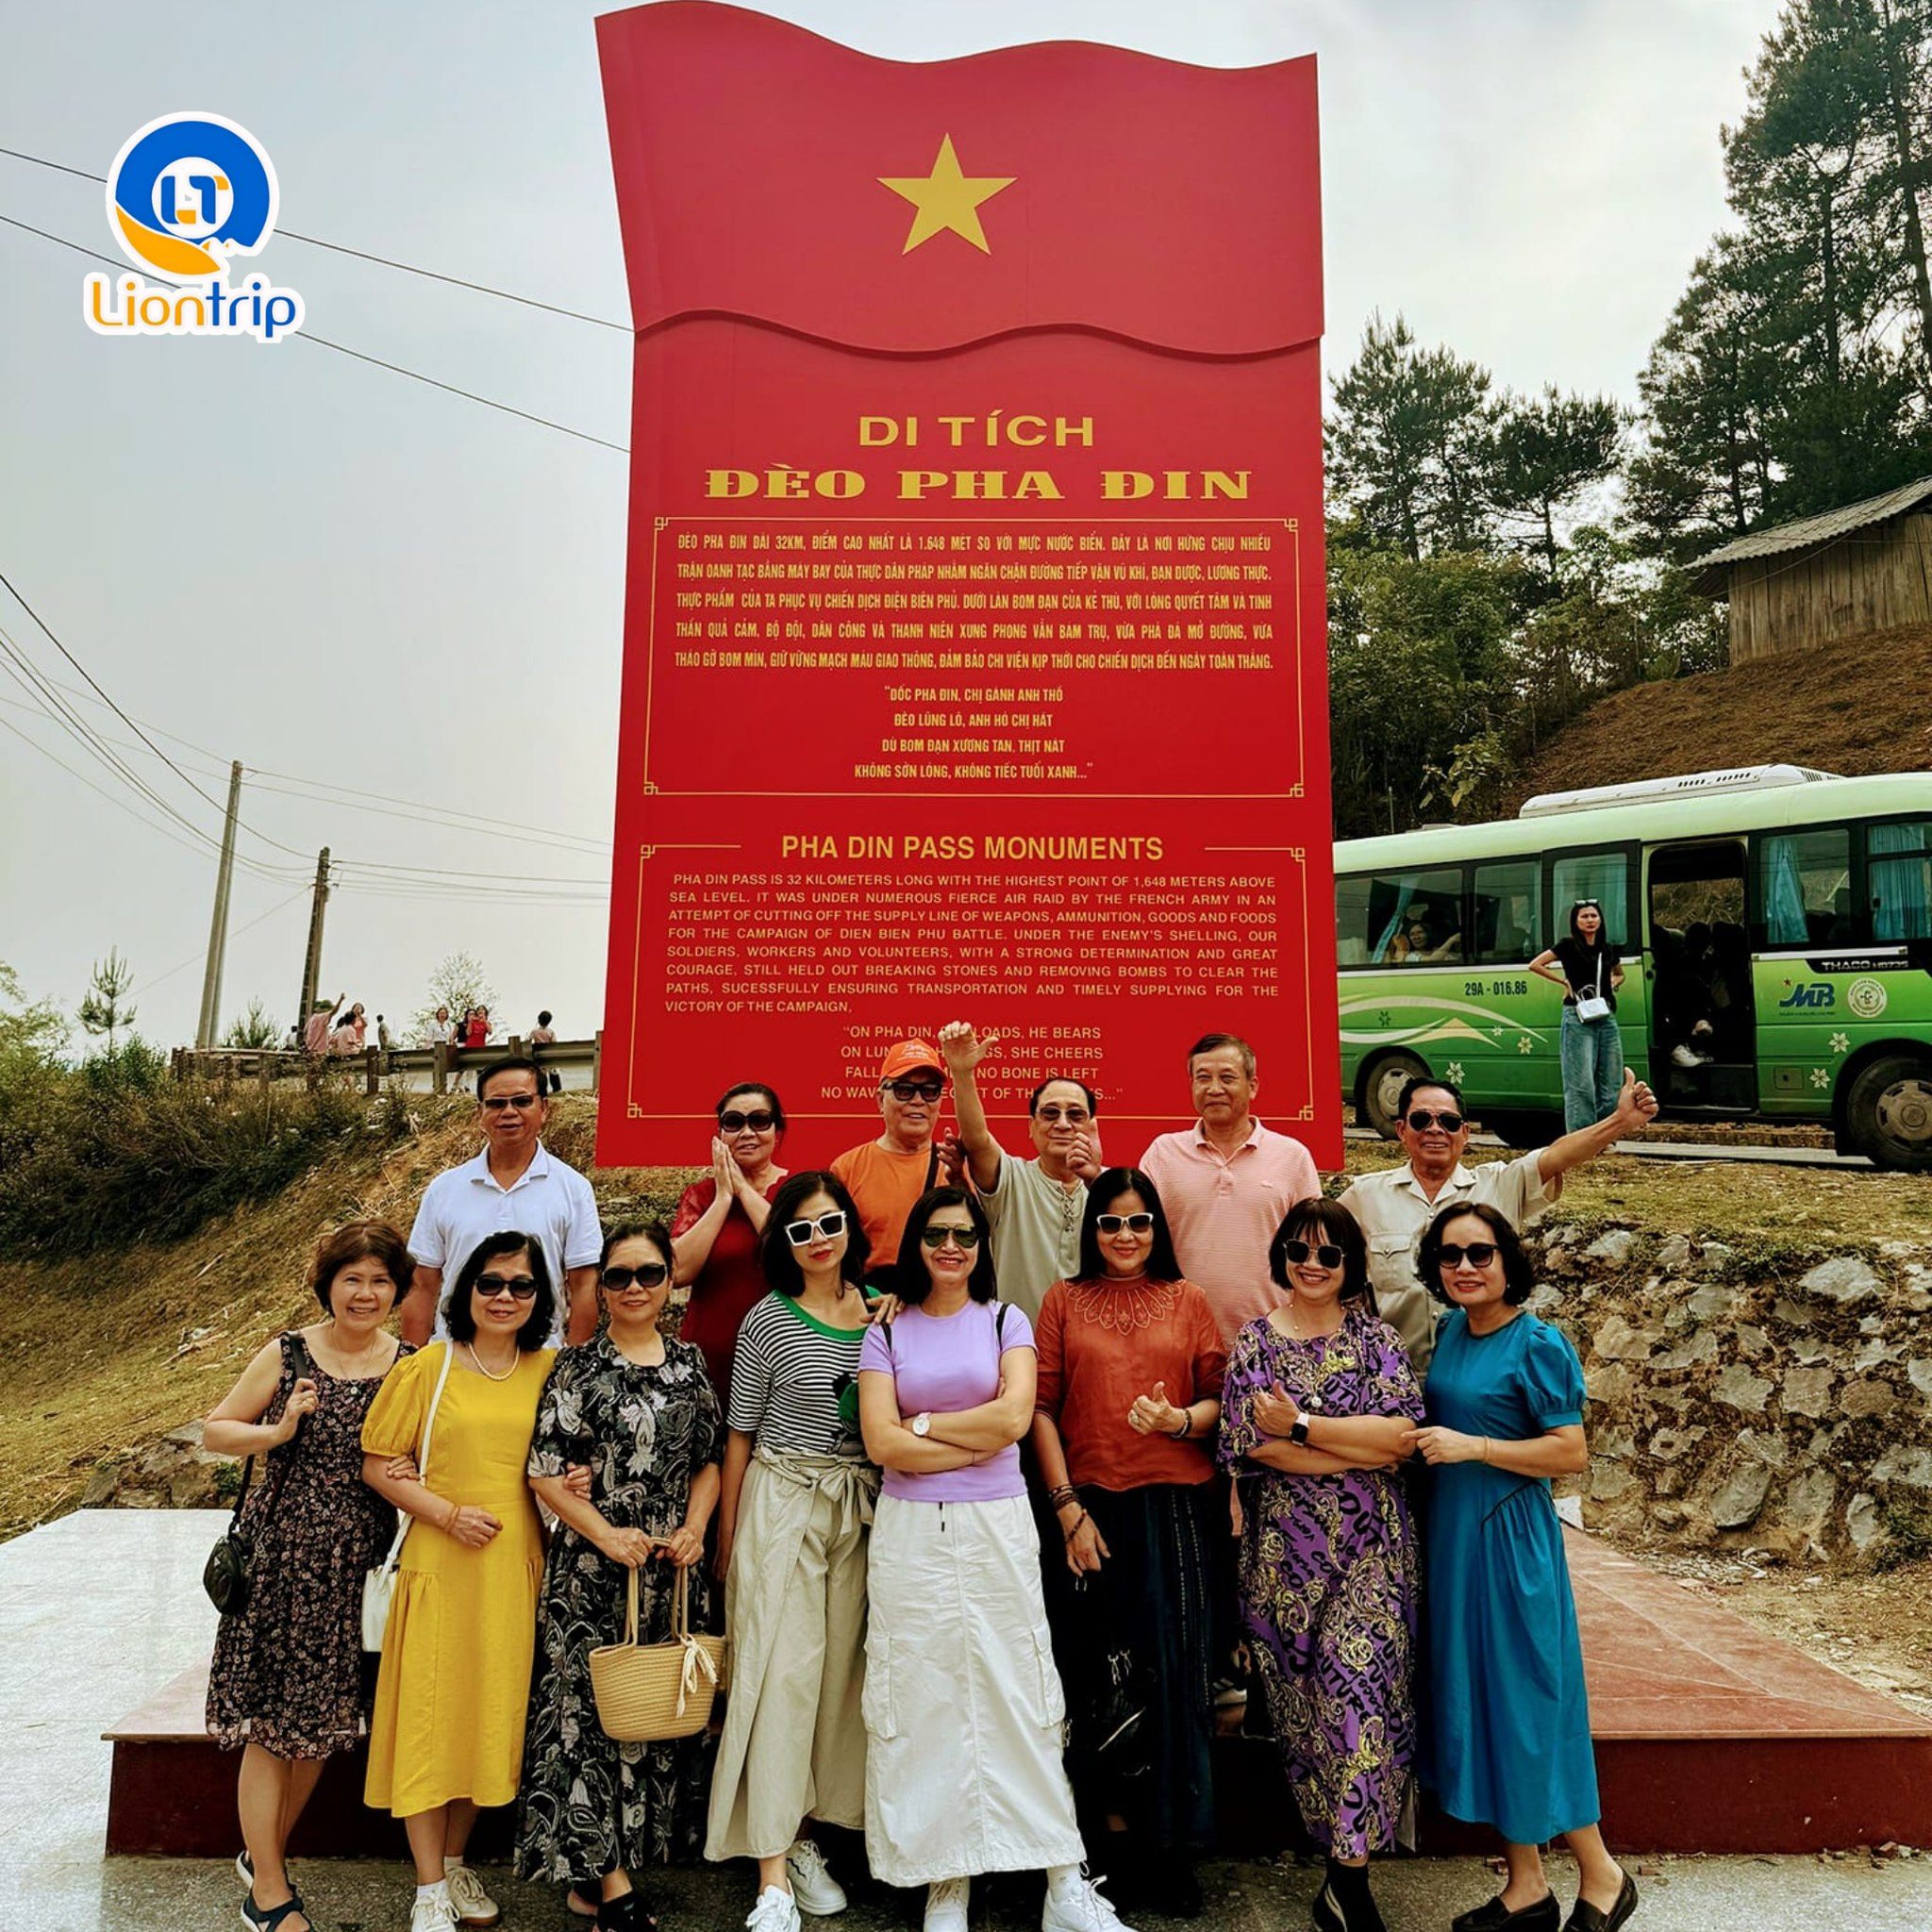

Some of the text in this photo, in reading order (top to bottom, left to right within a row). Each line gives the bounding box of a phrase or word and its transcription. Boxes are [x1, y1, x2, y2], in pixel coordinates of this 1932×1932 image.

[859, 408, 1093, 447] DI TÍCH
[705, 462, 1252, 500] ĐÈO PHA ĐIN
[703, 534, 724, 549] PHA
[774, 535, 807, 551] 32KM,
[842, 535, 863, 551] CAO
[976, 535, 991, 551] SO
[782, 835, 1163, 860] PHA DIN PASS MONUMENTS
[673, 874, 702, 885] PHA
[705, 874, 728, 885] DIN
[731, 874, 768, 886] PASS
[770, 874, 784, 886] IS
[805, 874, 892, 886] KILOMETERS
[895, 874, 934, 886] LONG
[937, 874, 972, 886] WITH
[974, 874, 1002, 887] THE
[1005, 874, 1065, 887] HIGHEST
[1068, 875, 1108, 887] POINT
[1111, 875, 1129, 887] OF
[1170, 875, 1226, 888] METERS
[1229, 875, 1275, 888] ABOVE
[669, 891, 697, 903] SEA
[757, 891, 770, 903] IT
[775, 891, 806, 904] WAS
[811, 891, 859, 904] UNDER
[865, 892, 942, 905] NUMEROUS
[948, 892, 997, 905] FIERCE
[1004, 892, 1026, 904] AIR
[1033, 892, 1065, 905] RAID
[1071, 893, 1090, 905] BY
[1095, 893, 1123, 905] THE
[1128, 893, 1185, 906] FRENCH
[1191, 893, 1230, 906] ARMY
[1237, 894, 1251, 906] IN
[1257, 894, 1276, 906] AN
[668, 909, 731, 921] ATTEMPT
[732, 909, 751, 922] OF
[753, 909, 813, 922] CUTTING
[815, 909, 842, 922] OFF
[843, 909, 872, 922] THE
[874, 909, 926, 922] SUPPLY
[928, 910, 958, 922] LINE
[961, 910, 980, 923] OF
[1147, 911, 1197, 924] GOODS
[1198, 911, 1227, 924] AND
[1229, 911, 1277, 924] FOODS
[668, 927, 696, 939] FOR
[703, 927, 729, 940] THE
[736, 927, 808, 940] CAMPAIGN
[814, 927, 833, 940] OF
[840, 927, 872, 940] DIEN
[878, 928, 910, 940] BIEN
[917, 928, 946, 941] PHU
[1013, 928, 1061, 941] UNDER
[1068, 929, 1095, 941] THE
[1248, 930, 1277, 942] OUR
[746, 945, 816, 958] WORKERS
[823, 946, 852, 958] AND
[958, 946, 993, 958] WITH
[1000, 947, 1010, 958] A
[1016, 946, 1073, 958] STRONG
[1079, 947, 1190, 959] DETERMINATION
[1196, 948, 1226, 959] AND
[1231, 948, 1278, 960] GREAT
[743, 964, 781, 976] STILL
[788, 964, 825, 976] HELD
[831, 964, 858, 976] OUT
[865, 964, 937, 976] BREAKING
[942, 964, 998, 976] STONES
[1004, 965, 1033, 977] AND
[1039, 965, 1111, 977] REMOVING
[1118, 965, 1167, 978] BOMBS
[1174, 966, 1193, 978] TO
[1198, 966, 1245, 978] CLEAR
[1251, 967, 1278, 978] THE
[1821, 960, 1871, 971] THACO
[721, 982, 820, 994] SUCESSFULLY
[827, 982, 899, 994] ENSURING
[907, 982, 1027, 995] TRANSPORTATION
[1036, 984, 1065, 995] AND
[1073, 984, 1122, 996] TIMELY
[1129, 984, 1208, 996] SUPPLYING
[1215, 985, 1243, 997] FOR
[1252, 985, 1279, 997] THE
[1464, 982, 1484, 996] 29A
[1492, 980, 1527, 996] 016.86
[664, 1000, 724, 1012] VICTORY
[725, 1000, 744, 1012] OF
[746, 1001, 774, 1012] THE
[875, 1026, 904, 1038] PHA
[1029, 1026, 1048, 1039] HE
[1053, 1026, 1102, 1039] BEARS
[841, 1046, 861, 1058] ON
[866, 1046, 891, 1058] LUN
[1010, 1047, 1040, 1058] SHE
[1044, 1047, 1103, 1058] CHEERS
[976, 1067, 998, 1079] NO
[1002, 1068, 1041, 1079] BONE
[1045, 1067, 1058, 1079] IS
[1063, 1068, 1099, 1079] LEFT
[821, 1087, 842, 1099] NO
[992, 1088, 1011, 1099] OF
[1015, 1088, 1035, 1099] TH
